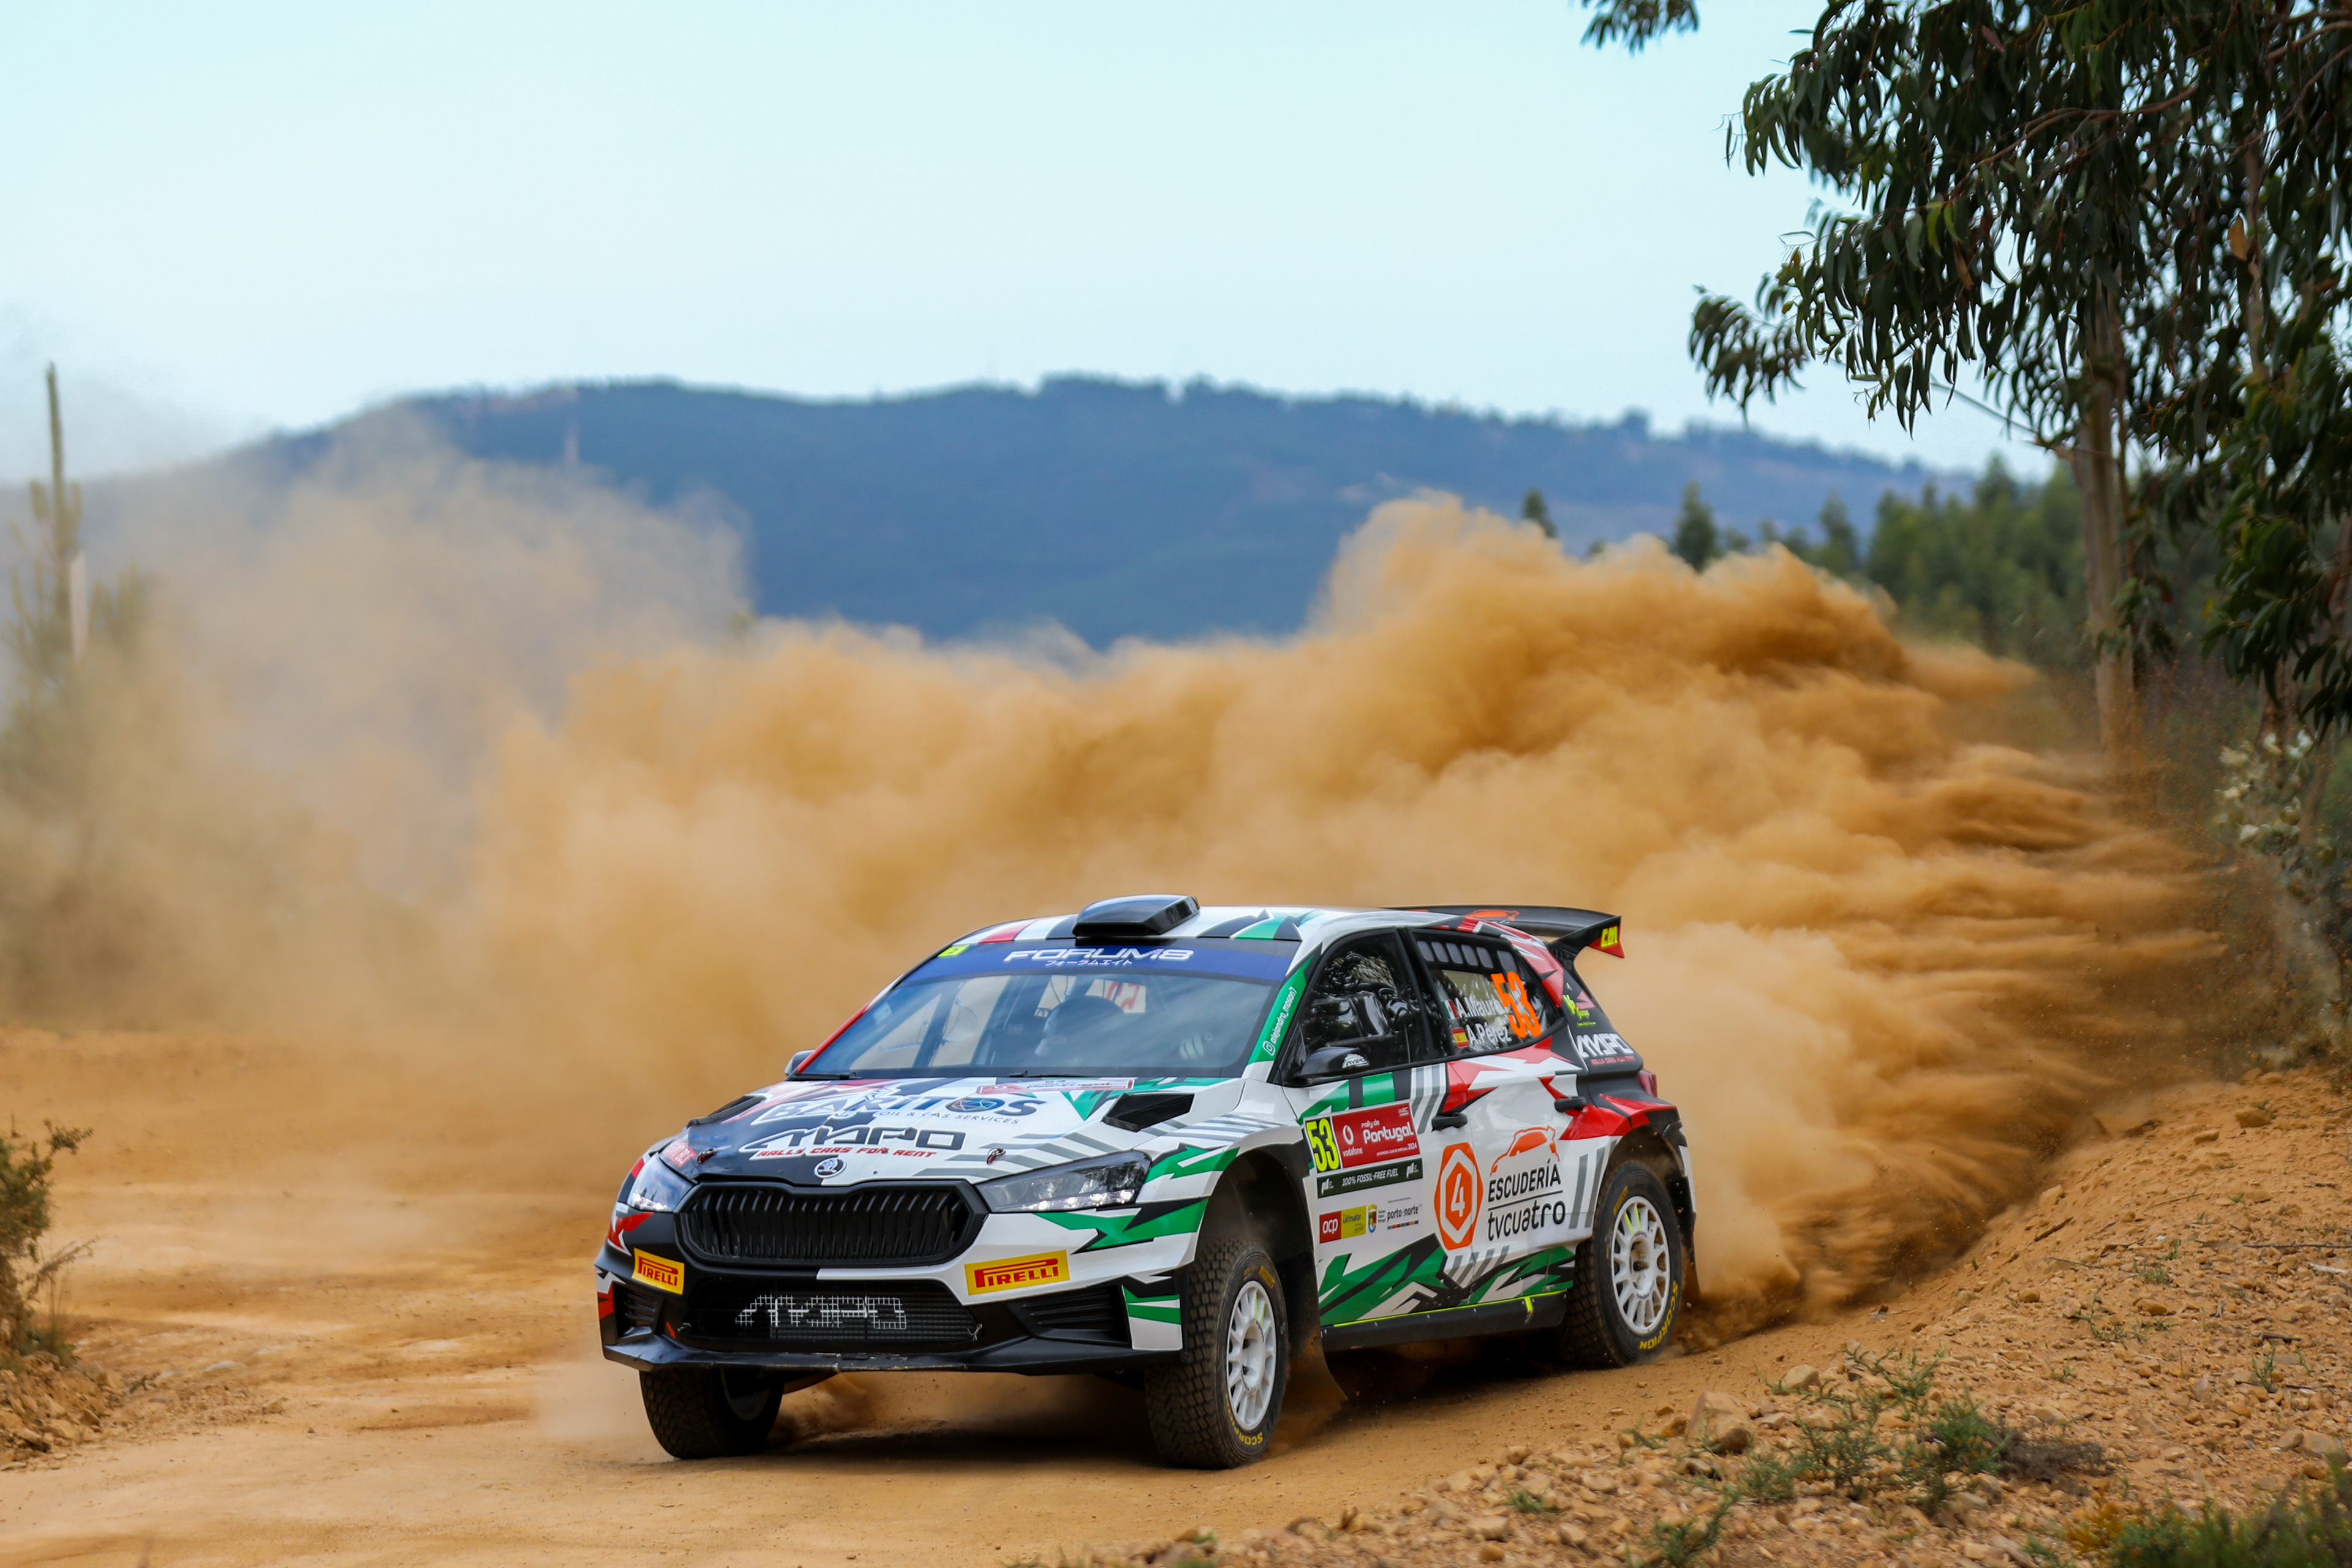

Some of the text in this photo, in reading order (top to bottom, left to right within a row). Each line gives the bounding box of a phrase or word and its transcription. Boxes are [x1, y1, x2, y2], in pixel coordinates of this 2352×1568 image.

[1003, 947, 1194, 962] FORUM8
[1490, 971, 1542, 1038] 53
[955, 1114, 1020, 1125] SERVICES
[1363, 1121, 1415, 1144] Portugal
[756, 1148, 804, 1157] RALLY
[892, 1150, 938, 1158] RENT
[1306, 1118, 1340, 1172] 53
[1342, 1146, 1363, 1157] vodafone
[1408, 1142, 1417, 1150] 2024
[1341, 1177, 1356, 1186] 100%
[1387, 1167, 1399, 1177] FUEL
[1488, 1158, 1561, 1202] ESCUDERÍA
[1450, 1172, 1466, 1218] 4
[1487, 1199, 1566, 1241] tvcuatro
[637, 1254, 679, 1287] PIRELLI
[974, 1257, 1059, 1289] PIRELLI
[1639, 1280, 1679, 1349] SCORPION
